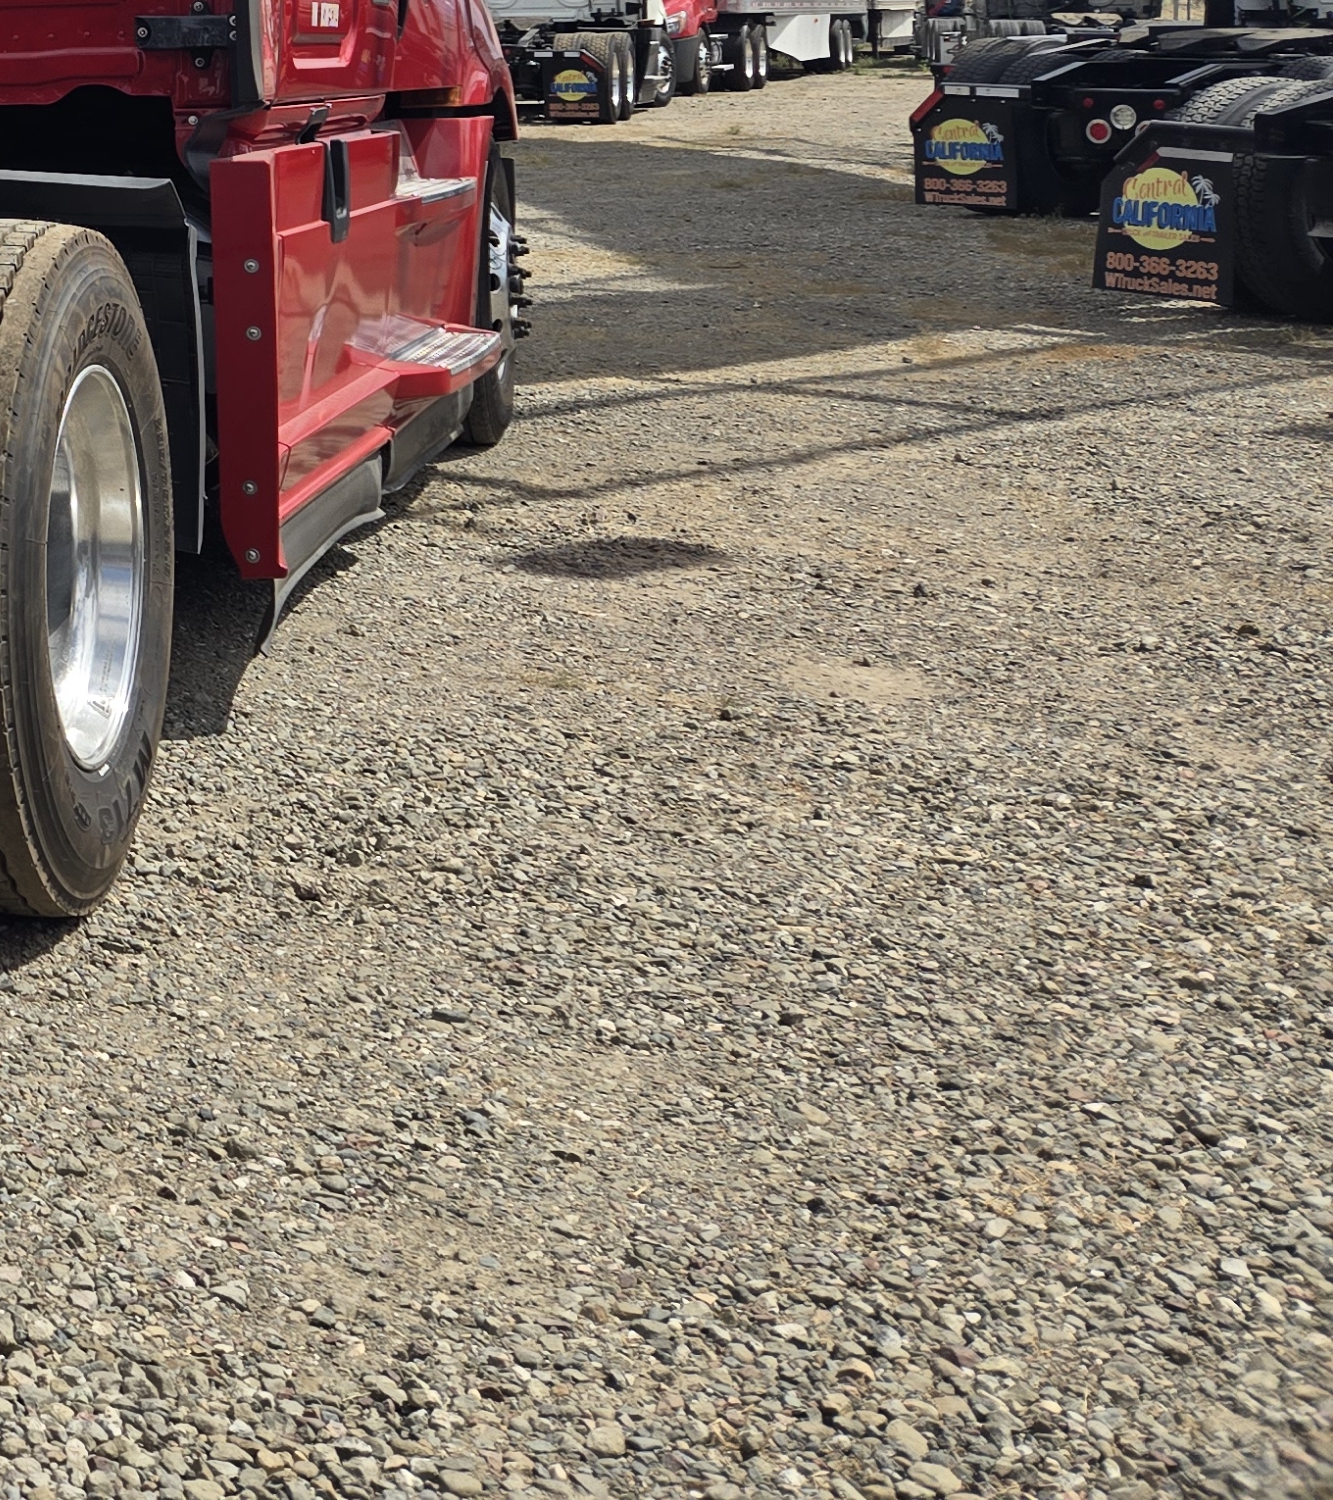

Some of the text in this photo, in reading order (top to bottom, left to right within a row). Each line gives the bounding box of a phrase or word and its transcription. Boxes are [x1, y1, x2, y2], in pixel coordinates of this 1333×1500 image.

[925, 140, 1004, 160] CALIFORNIA
[1123, 171, 1188, 199] Central
[1113, 197, 1217, 232] CALIFORNIA
[1106, 251, 1219, 280] 800-366-3263
[1105, 272, 1218, 299] WTruckSales.net
